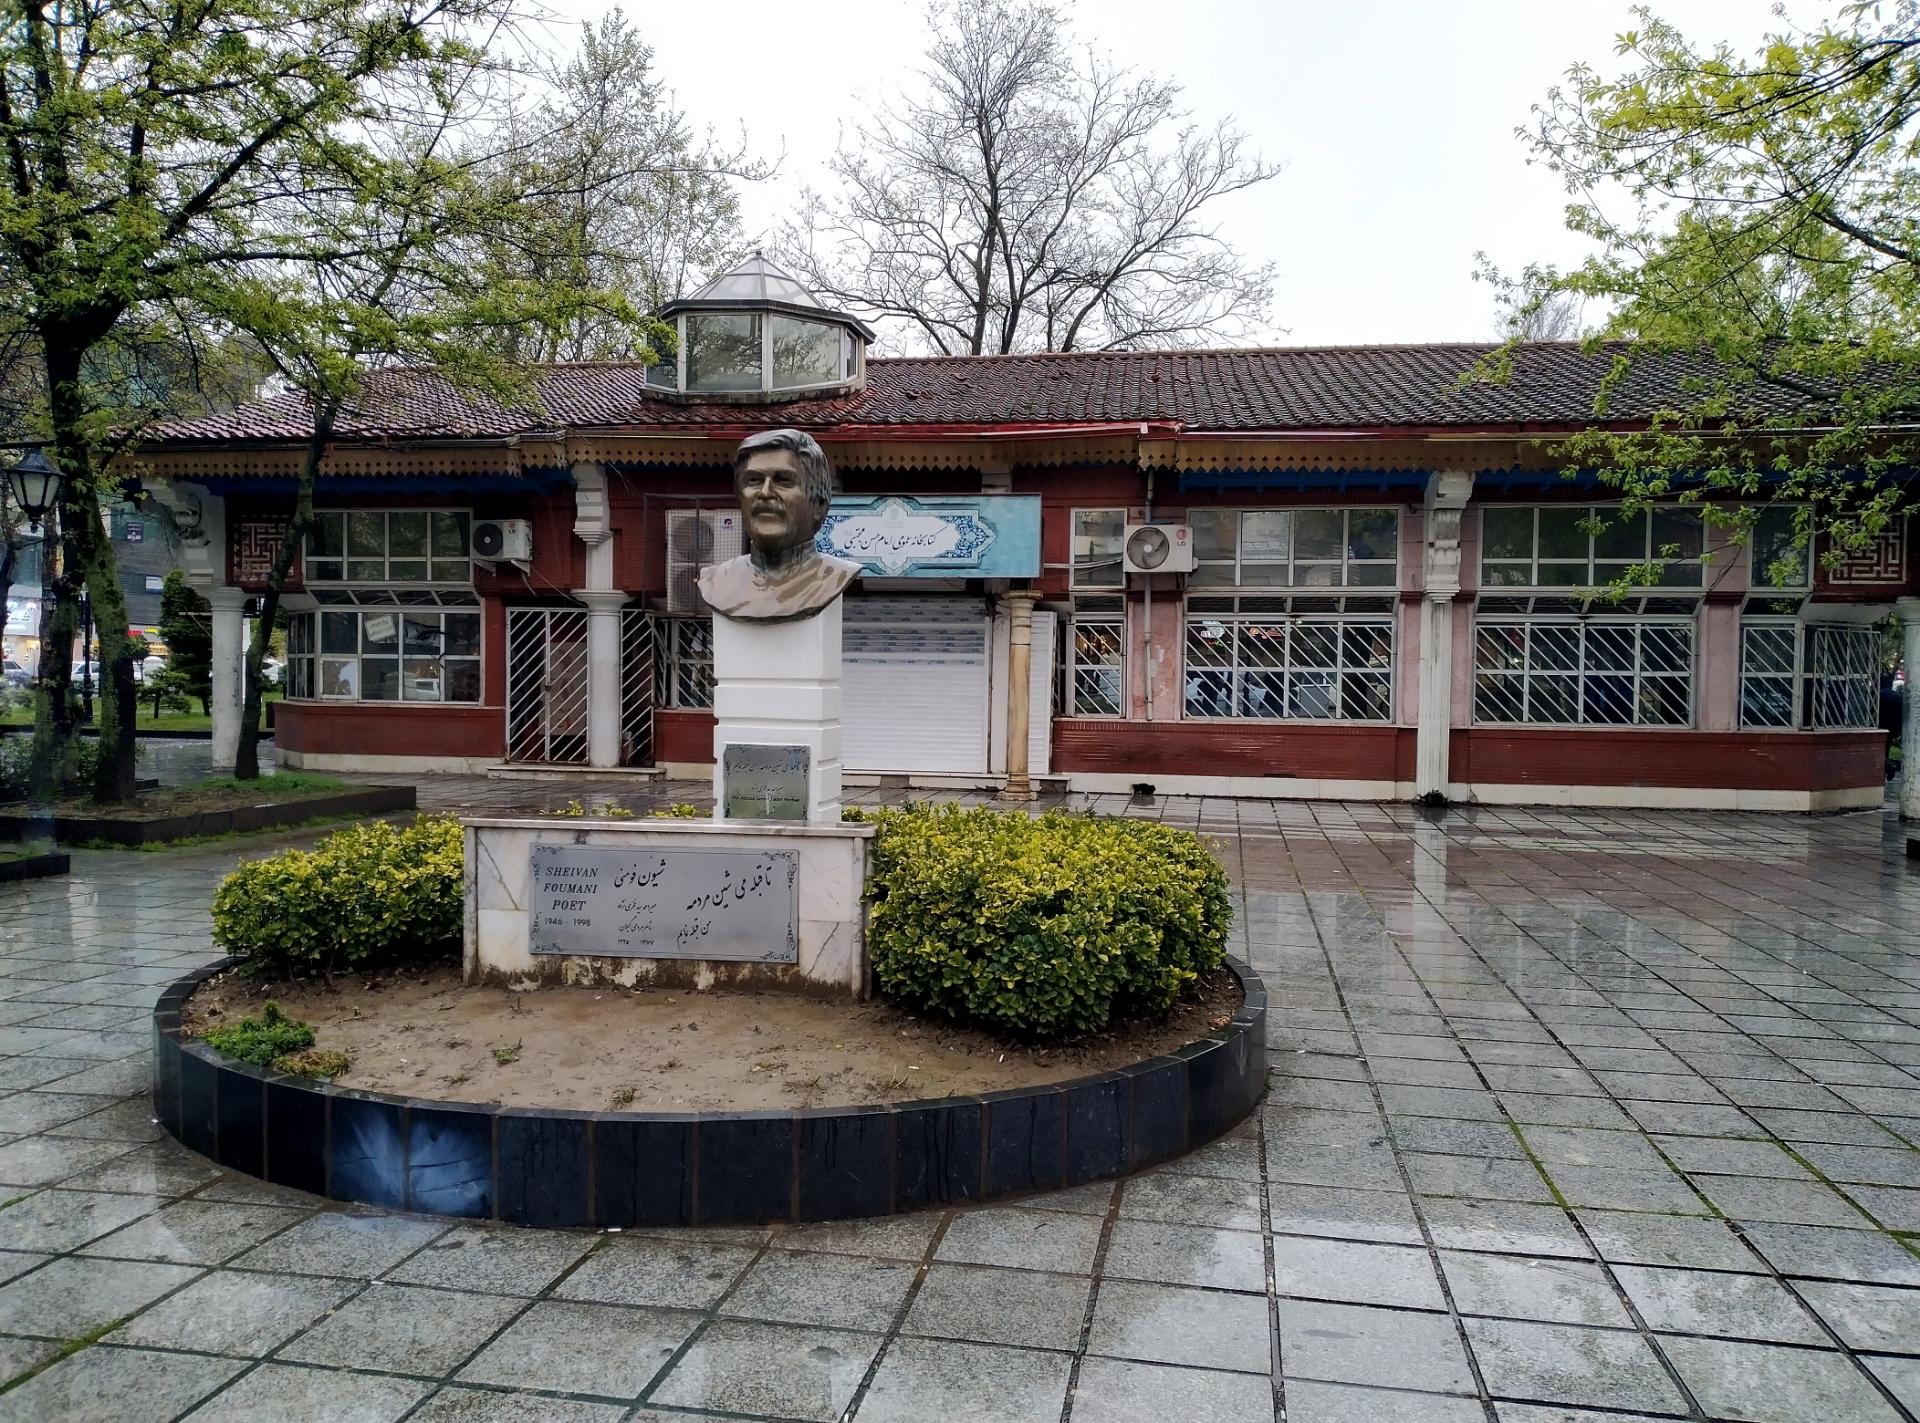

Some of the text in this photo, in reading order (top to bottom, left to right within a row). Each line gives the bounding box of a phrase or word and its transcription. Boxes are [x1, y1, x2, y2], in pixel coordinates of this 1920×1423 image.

[844, 525, 949, 555] کتابخانه عمومی امام حسن مجتبی
[545, 866, 598, 878] SHEIVAN
[613, 858, 666, 888] شیون فومنی
[750, 864, 763, 897] قبله
[766, 866, 773, 887] تا
[543, 882, 598, 894] FOUMANI
[735, 878, 746, 899] می
[552, 899, 587, 911] POET
[700, 920, 712, 936] من
